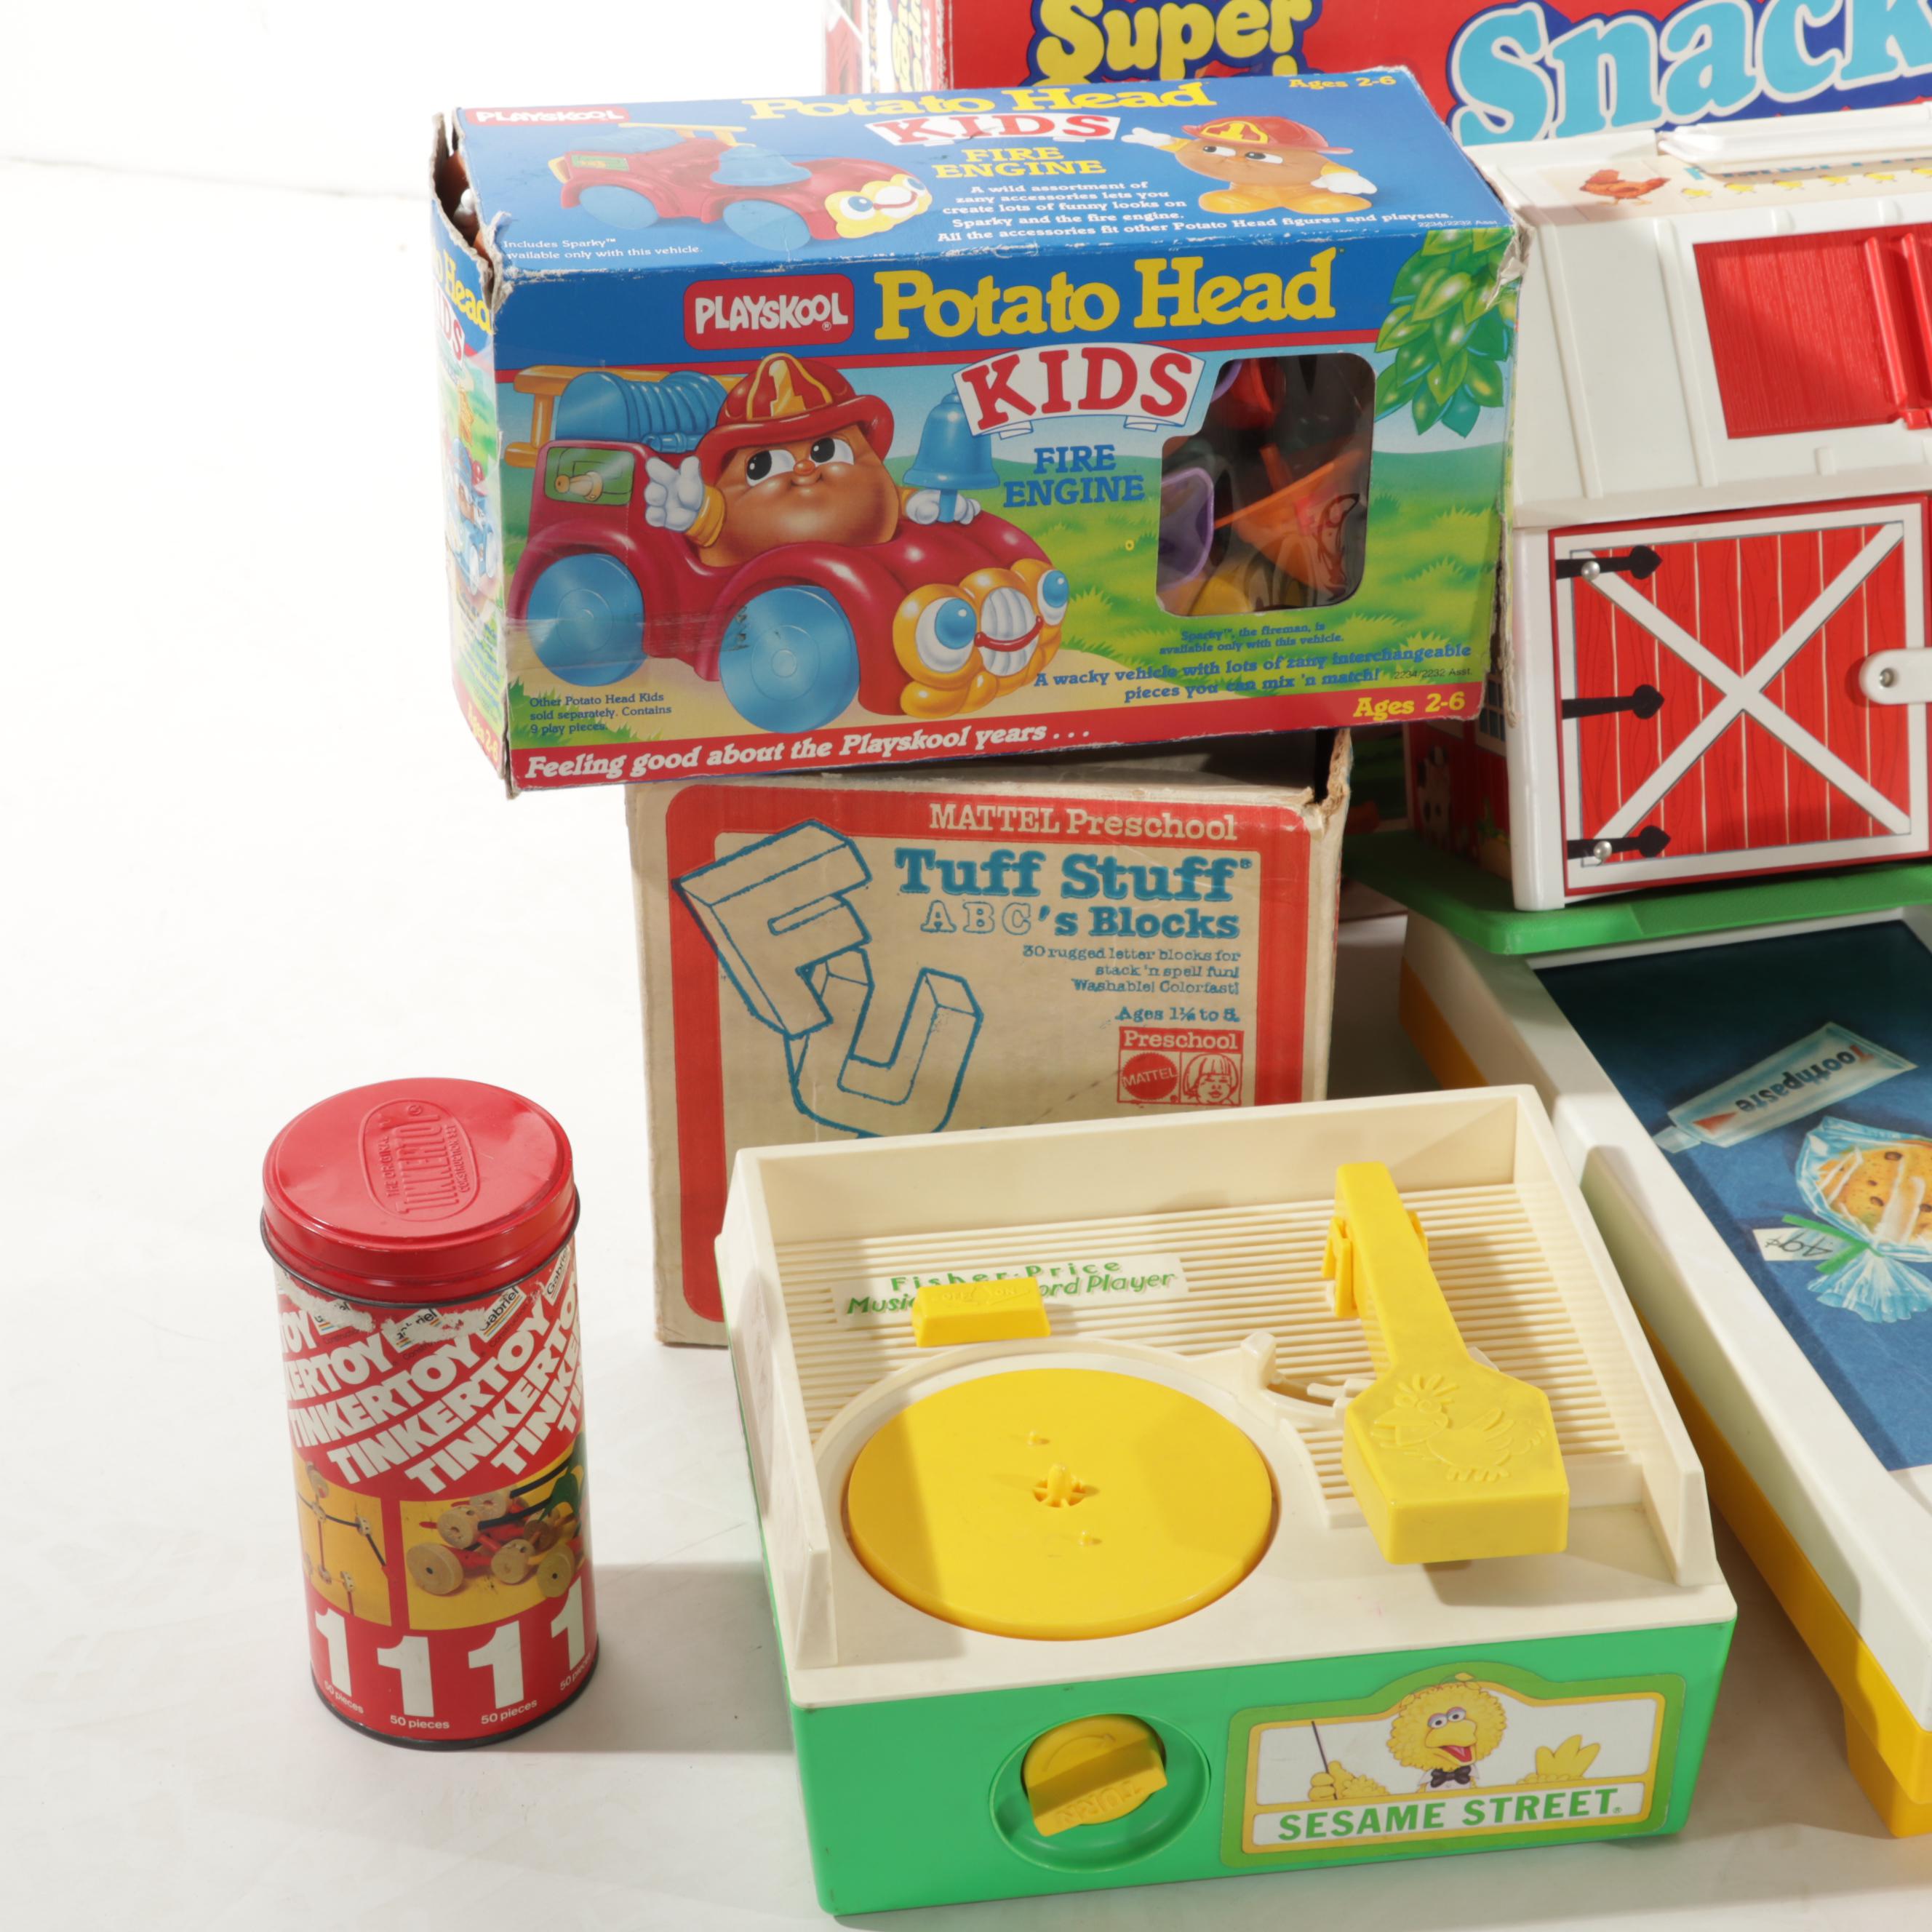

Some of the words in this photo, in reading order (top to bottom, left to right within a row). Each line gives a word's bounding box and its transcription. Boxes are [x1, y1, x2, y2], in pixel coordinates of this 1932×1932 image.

[1037, 0, 1314, 81] Super
[1288, 78, 1348, 90] Ages
[1355, 76, 1397, 87] 2-6
[742, 92, 996, 119] Potato
[1000, 81, 1217, 111] Head
[475, 108, 625, 124] PLAYSKOOL
[873, 113, 1111, 143] KIDS
[960, 147, 1064, 163] FIRE
[931, 160, 1106, 178] ENGINE
[956, 194, 994, 204] zany
[1001, 191, 1098, 202] accessories
[1102, 191, 1132, 199] lets
[1138, 190, 1170, 200] you
[971, 185, 984, 193] A
[989, 184, 1026, 193] wild
[1031, 182, 1126, 192] assortment
[1130, 181, 1149, 190] of
[942, 205, 994, 215] create
[999, 203, 1031, 212] lots
[1036, 201, 1055, 212] of
[1058, 201, 1108, 212] funny
[1112, 199, 1159, 209] looks
[1164, 199, 1187, 208] on
[937, 232, 961, 242] All
[966, 231, 994, 240] the
[999, 226, 1096, 238] accessories
[1101, 225, 1119, 234] fit
[1124, 223, 1168, 233] other
[1173, 220, 1227, 231] Potato
[1232, 217, 1278, 228] Head
[1281, 215, 1341, 227] figures
[1346, 214, 1376, 223] and
[1381, 212, 1454, 223] playsets.
[951, 217, 1013, 228] Sparky
[1018, 215, 1051, 225] and
[1055, 213, 1082, 223] the
[1087, 212, 1118, 222] fire
[1122, 210, 1184, 222] engine.
[502, 239, 558, 249] Includes
[564, 250, 591, 260] only
[595, 249, 623, 258] with
[628, 247, 651, 257] this
[654, 245, 703, 255] vehicle.
[874, 270, 1120, 341] Potato
[1133, 246, 1336, 330] Head
[961, 345, 1197, 431] KIDS
[1033, 444, 1117, 474] FIRE
[1003, 474, 1146, 508] ENGINE
[1239, 628, 1258, 638] the
[1315, 622, 1325, 631] is
[1159, 643, 1213, 655] available
[1217, 640, 1242, 652] only
[1246, 639, 1271, 649] with
[1275, 636, 1296, 647] this
[1301, 634, 1344, 644] vehicle.
[1034, 674, 1048, 687] A
[1053, 668, 1110, 685] wacky
[1115, 665, 1178, 681] vehicle
[1183, 660, 1221, 677] with
[1226, 660, 1258, 674] lots
[1263, 656, 1282, 671] of
[1286, 655, 1328, 669] zany
[1332, 643, 1472, 665] interchangeable
[1393, 668, 1446, 680] 2234/2232
[1450, 667, 1473, 677] Asst.
[1124, 684, 1181, 703] pieces
[1185, 683, 1219, 699] you
[1226, 679, 1257, 692] can
[1262, 675, 1295, 690] mix
[1301, 673, 1317, 687] 'n
[1322, 667, 1381, 684] match!
[530, 697, 562, 708] Other
[565, 695, 602, 706] Potato
[605, 693, 636, 704] Head
[639, 692, 665, 703] Kids
[1353, 696, 1416, 722] Ages
[1425, 691, 1466, 713] 2-6
[530, 710, 554, 721] sold
[557, 707, 619, 722] separately.
[622, 706, 672, 716] Contains
[530, 724, 539, 734] 9
[541, 723, 565, 737] play
[524, 753, 628, 781] Feeling
[630, 745, 703, 778] good
[706, 743, 786, 767] about
[790, 737, 833, 760] the
[839, 725, 973, 758] Playskool
[975, 724, 1047, 751] years
[929, 802, 1060, 834] MATTEL
[1066, 808, 1237, 841] Preschool
[894, 847, 1046, 898] Tuff
[1088, 906, 1241, 939] Blocks
[1022, 944, 1045, 959] 30
[1047, 947, 1106, 961] rugged
[1109, 947, 1155, 960] letter
[1159, 948, 1213, 962] blocks
[1214, 949, 1242, 962] for
[1095, 965, 1140, 977] stack
[1162, 965, 1202, 979] spell
[1206, 965, 1240, 978] fun!
[1071, 977, 1155, 993] Washable!
[1159, 980, 1240, 995] Colorfast!
[1114, 1005, 1164, 1022] Ages
[1199, 1007, 1219, 1022] to
[1123, 1030, 1239, 1050] Preschool
[1122, 1067, 1179, 1087] MATTEL
[1734, 1044, 1875, 1112] Toothpaste
[1086, 1273, 1176, 1293] Player
[289, 1334, 481, 1448] TINKERTOY
[327, 1292, 551, 1485] TINKERTOY
[551, 1576, 586, 1672] 1
[314, 1608, 352, 1697] 1
[467, 1619, 524, 1709] 1
[376, 1634, 435, 1717] 1
[559, 1675, 572, 1691] 50
[324, 1680, 335, 1695] 50
[335, 1690, 364, 1715] pieces
[389, 1715, 407, 1727] 50
[408, 1718, 450, 1730] pieces
[480, 1712, 499, 1725] 50
[500, 1699, 538, 1721] pieces
[1278, 1801, 1446, 1842] SESAME
